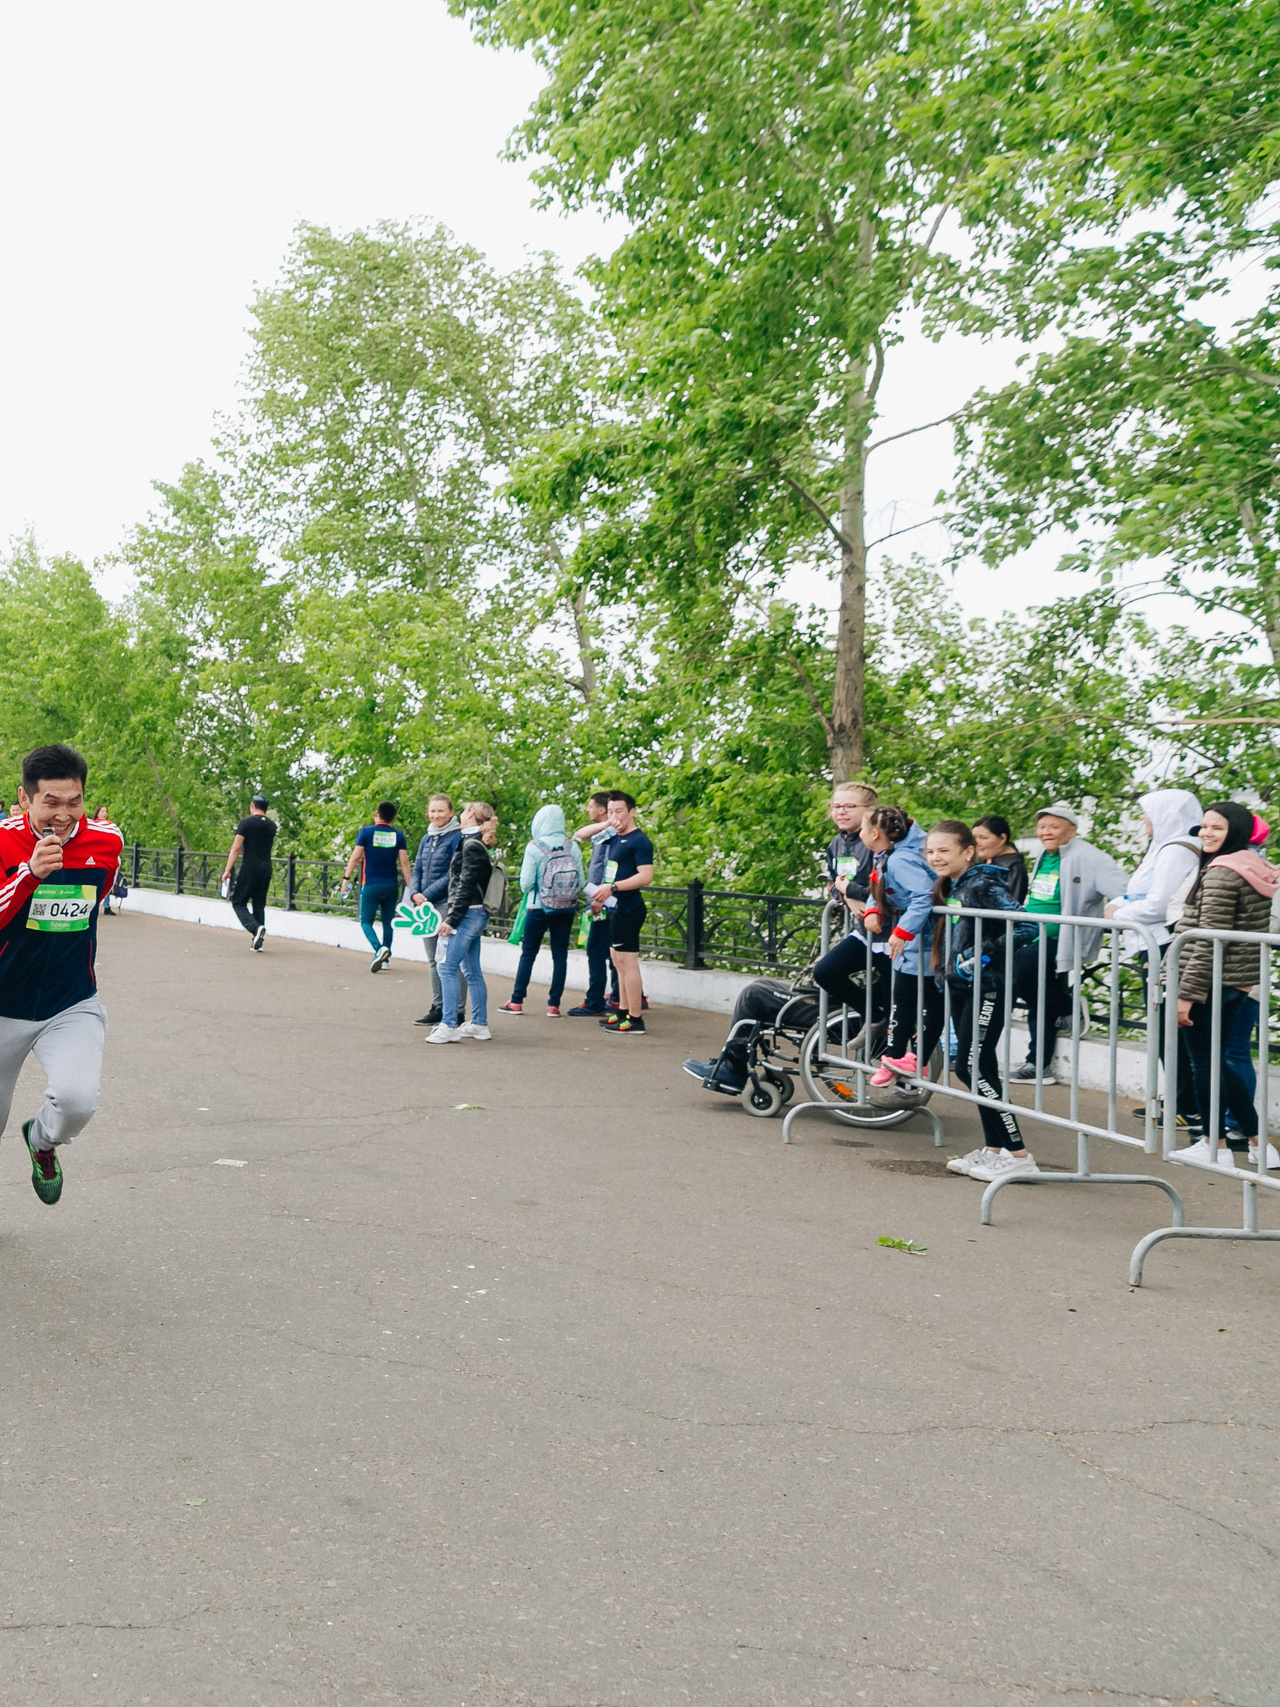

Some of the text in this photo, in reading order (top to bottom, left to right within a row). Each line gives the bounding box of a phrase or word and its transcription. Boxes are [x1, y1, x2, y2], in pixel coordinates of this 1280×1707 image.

[50, 903, 89, 917] 0424
[979, 1000, 995, 1026] READY
[977, 1079, 999, 1099] READY
[1000, 1111, 1017, 1133] READY
